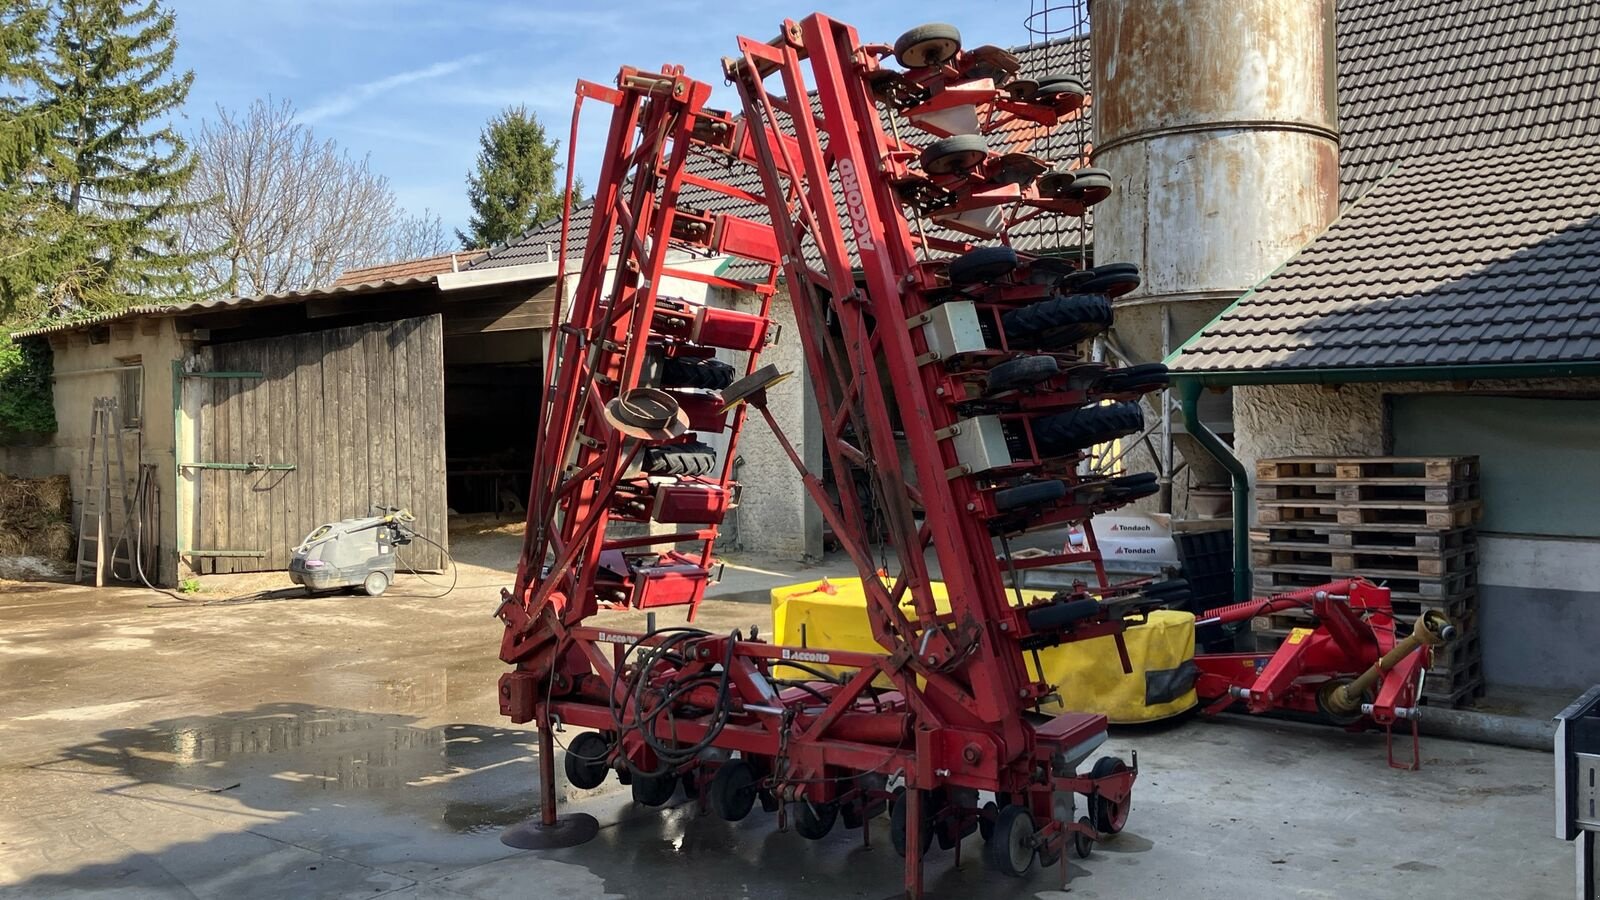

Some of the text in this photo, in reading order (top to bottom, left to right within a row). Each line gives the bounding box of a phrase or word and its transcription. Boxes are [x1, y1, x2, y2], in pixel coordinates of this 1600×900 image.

[839, 158, 875, 251] ACCORD
[606, 634, 638, 645] ACCORD
[791, 651, 830, 664] ACCORD
